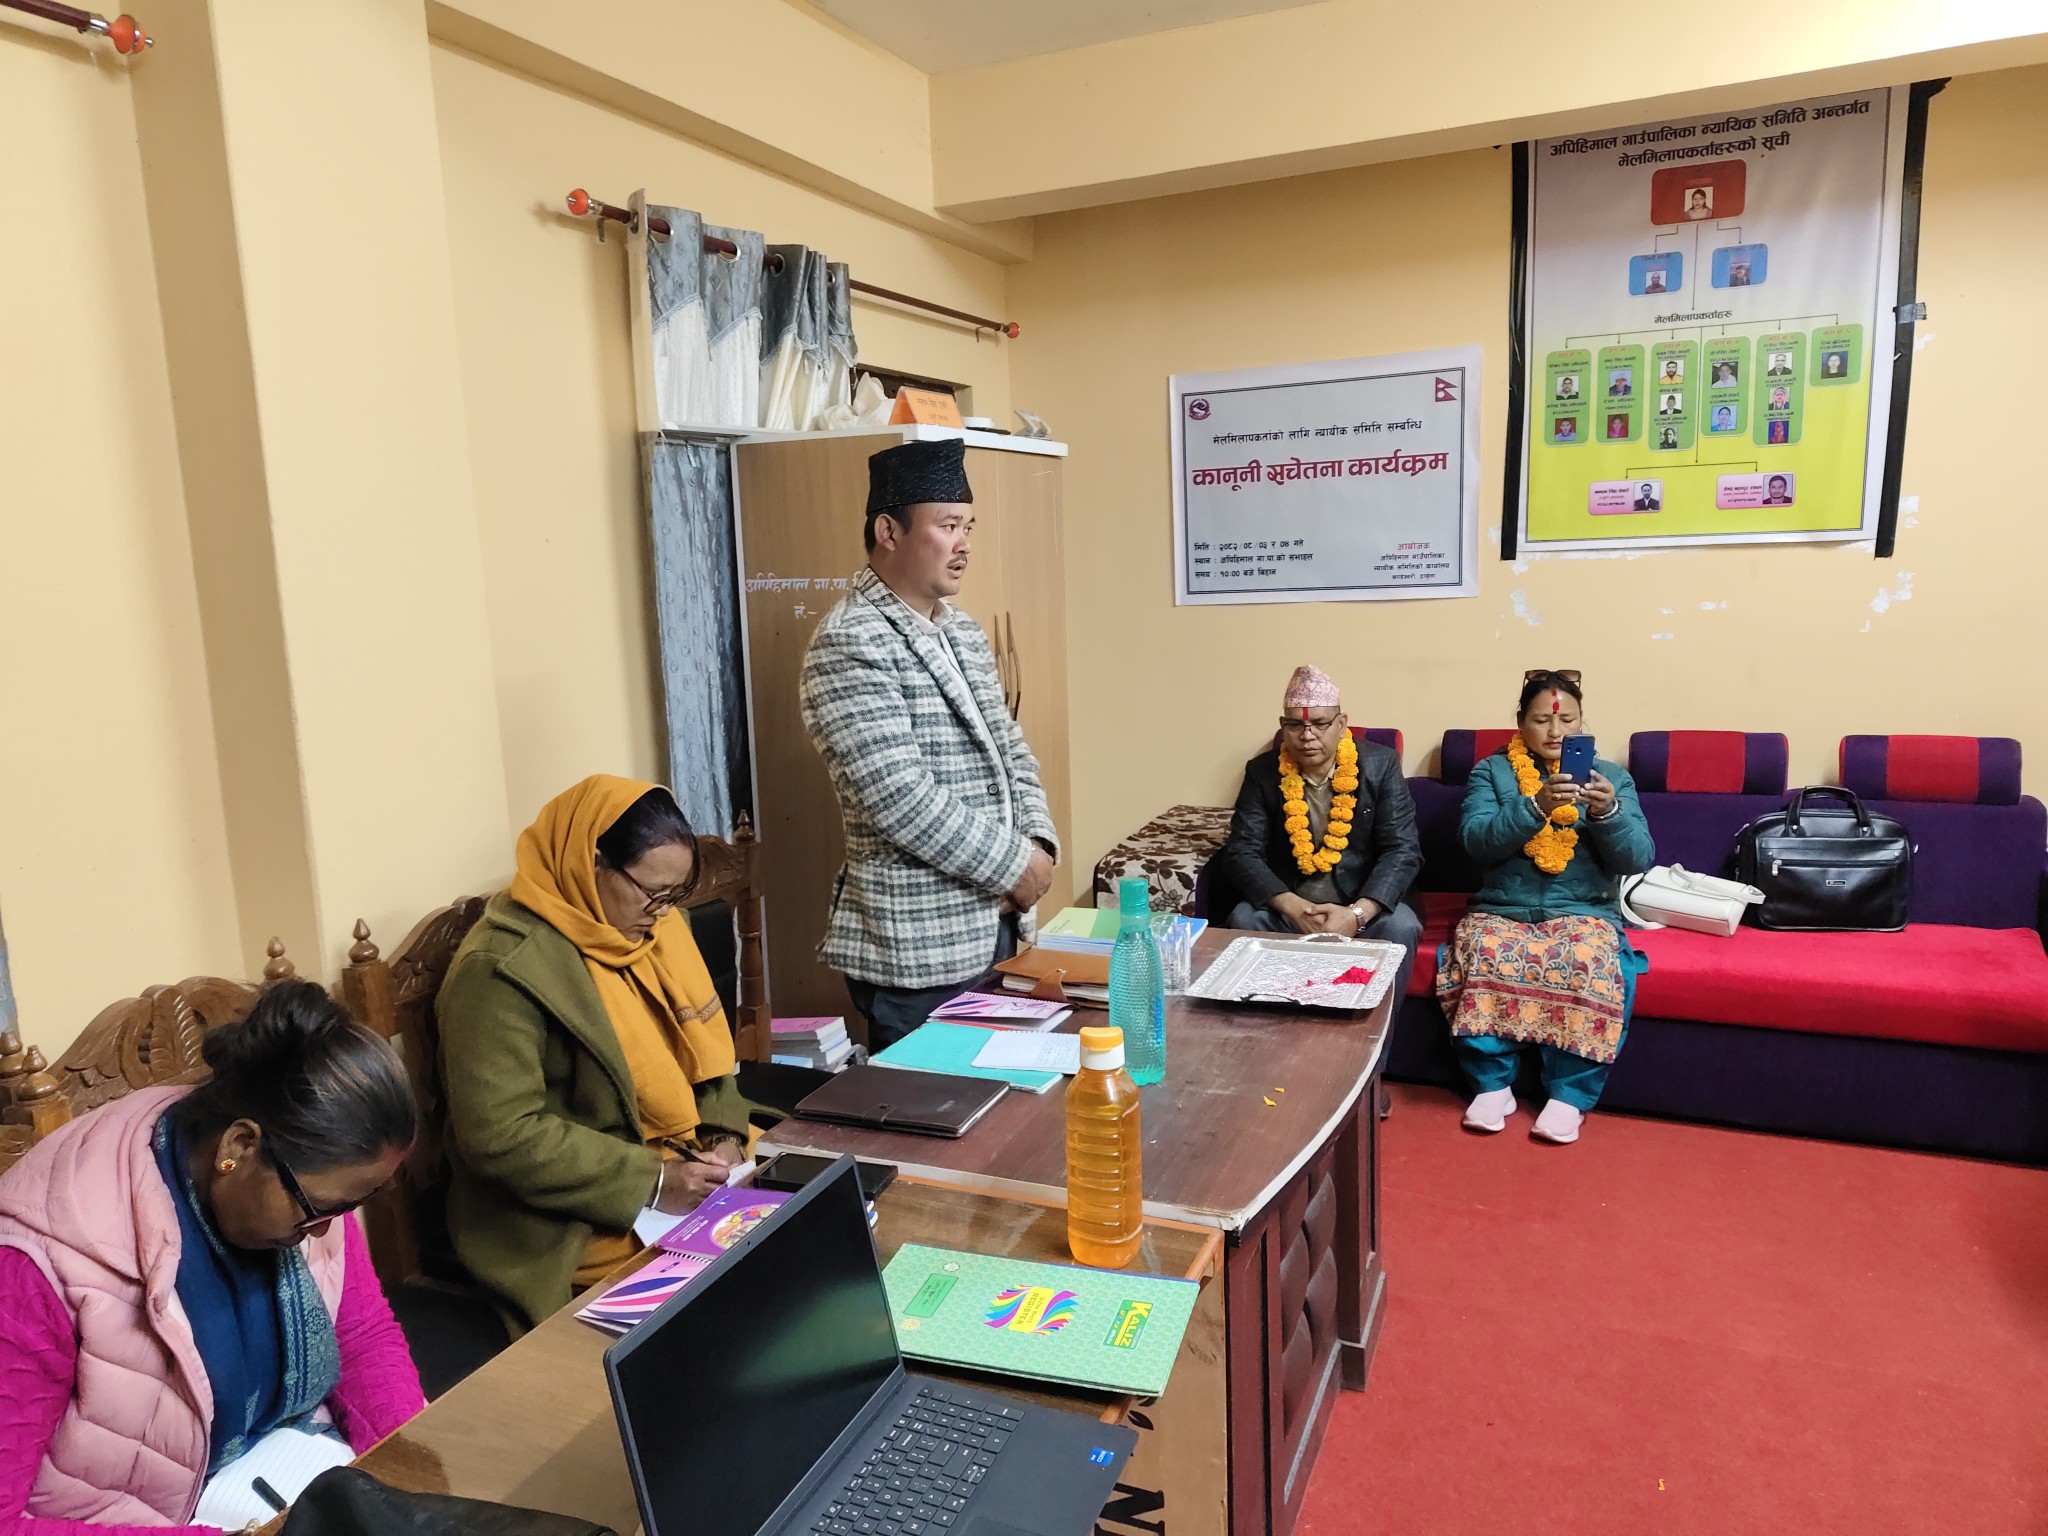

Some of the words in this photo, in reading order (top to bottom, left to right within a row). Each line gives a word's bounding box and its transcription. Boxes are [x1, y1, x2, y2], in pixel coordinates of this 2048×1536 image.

[1550, 137, 1618, 156] अपिहिमाल
[1622, 126, 1697, 147] गाउँपालिका
[1701, 116, 1757, 135] न्यायिक
[1762, 108, 1808, 128] समिति
[1812, 100, 1871, 121] अन्तर्गत
[1618, 136, 1756, 167] मेलमिलापकर्ताहरुको
[1761, 131, 1791, 151] सूची
[1213, 429, 1283, 446] मेलमिलापकर्ताको
[1289, 427, 1310, 440] लागि
[1315, 424, 1349, 437] न्यायीक
[1353, 420, 1382, 435] समिति
[1387, 418, 1423, 433] सम्बन्धि
[1192, 458, 1262, 491] कानूनी
[1348, 449, 1449, 477] कार्यक्रम
[1194, 541, 1210, 551] मिति
[1220, 554, 1254, 564] अपिहिमाल
[1397, 541, 1432, 550] आयोजक
[1017, 1292, 1039, 1325] REGISTER
[1115, 1301, 1153, 1347] KALIZ
